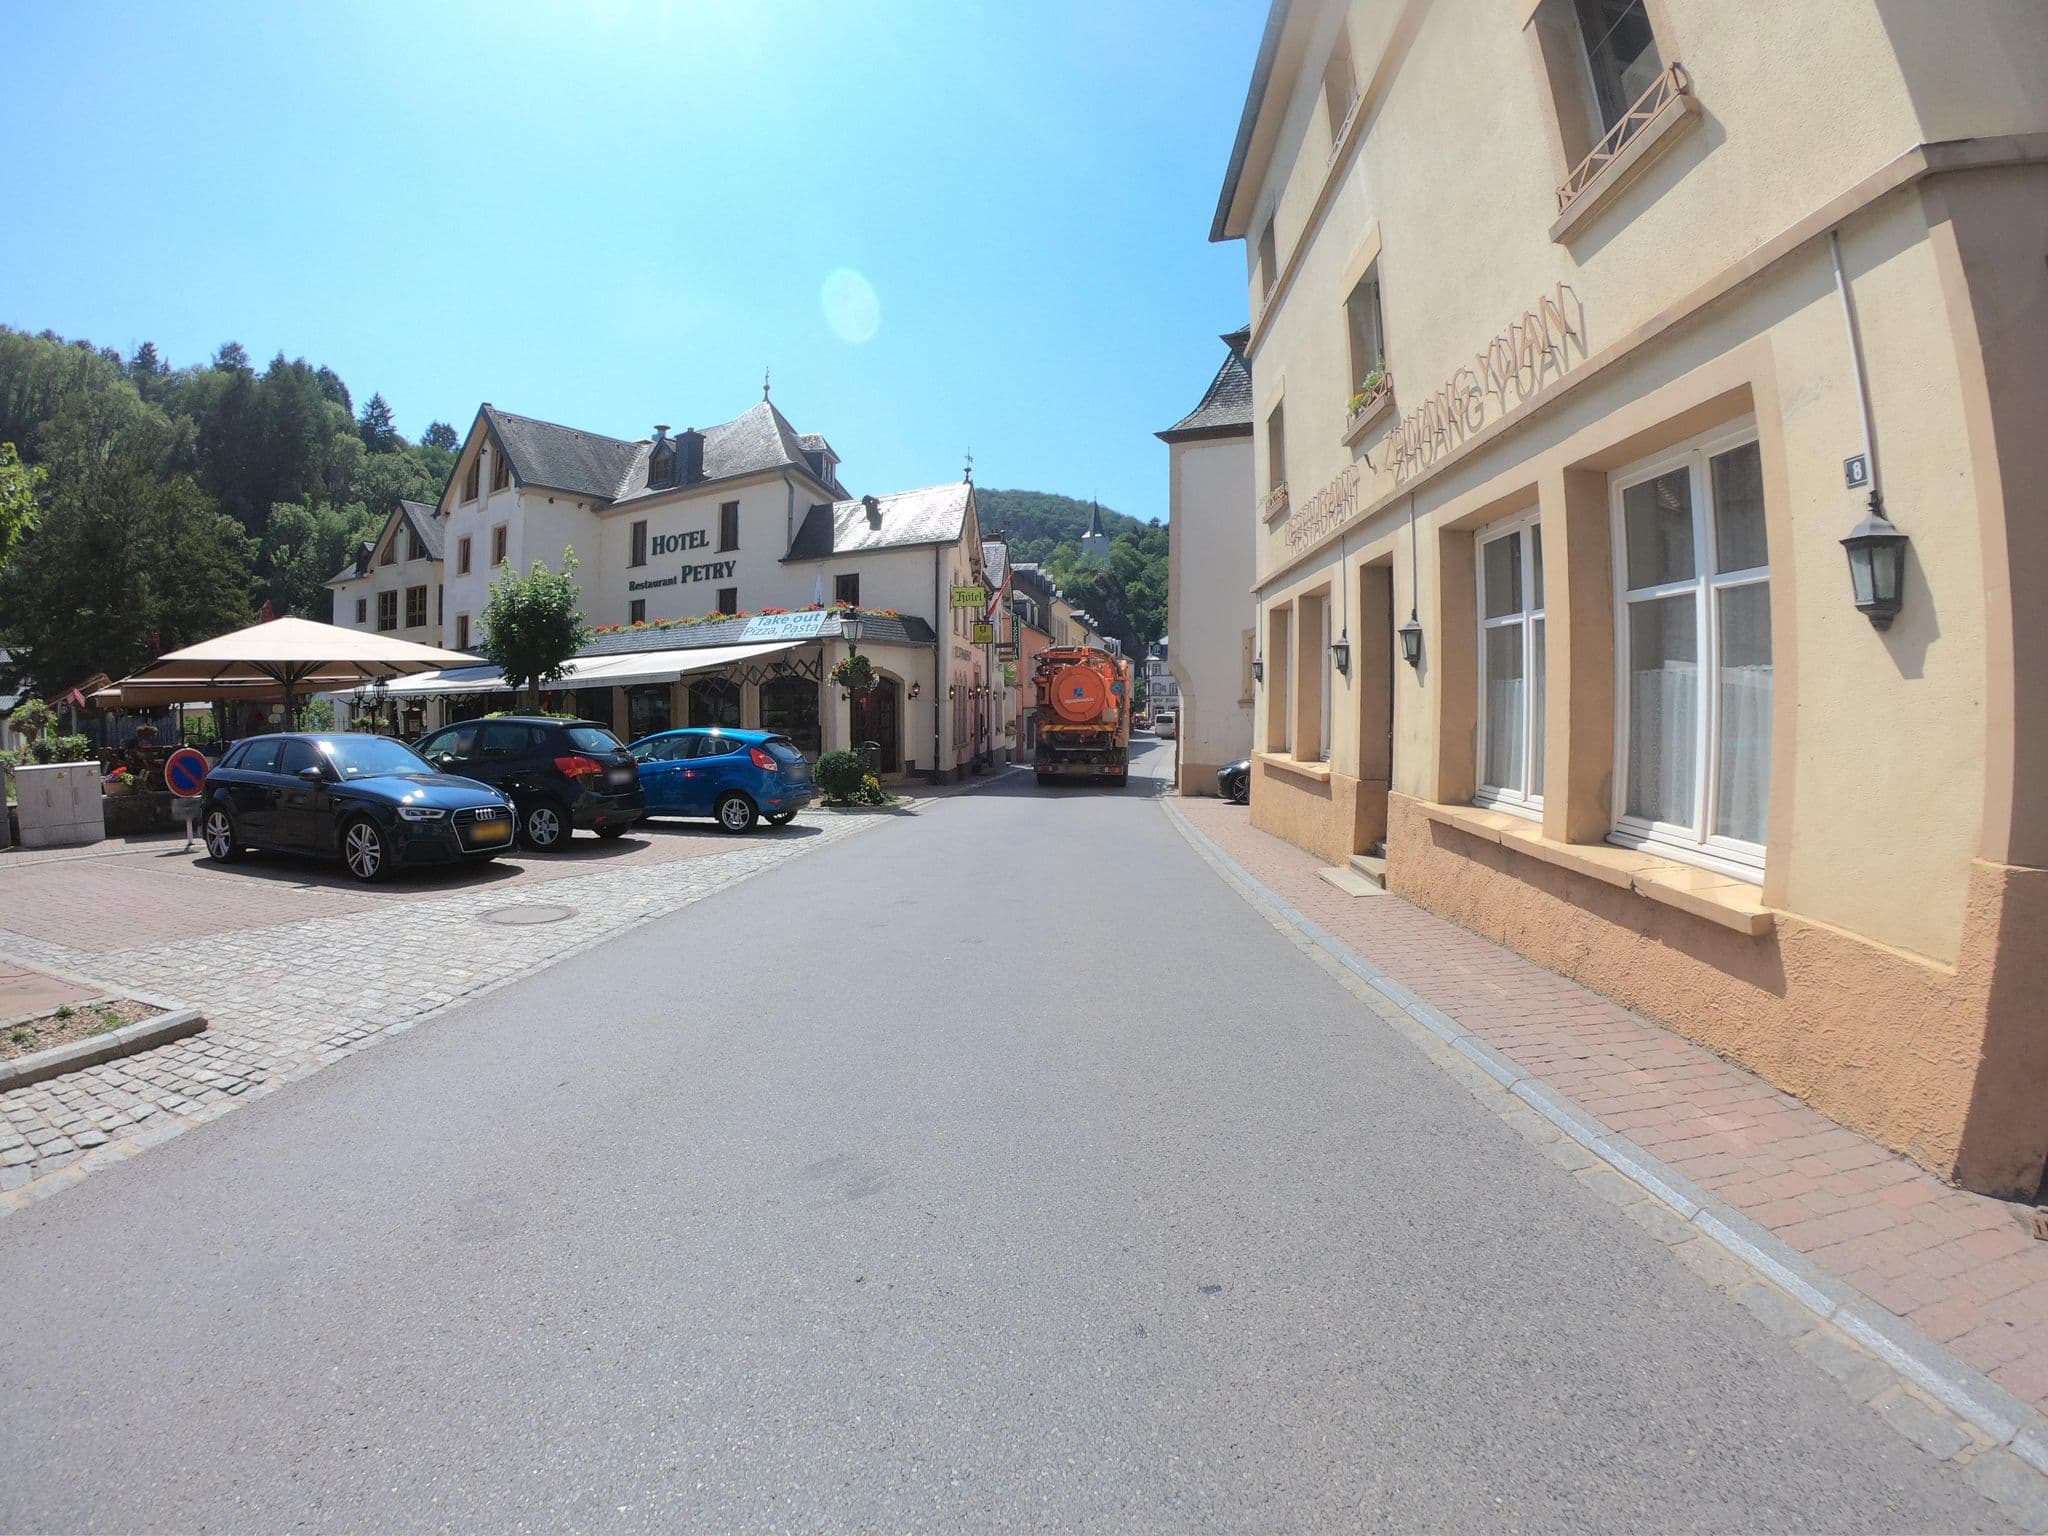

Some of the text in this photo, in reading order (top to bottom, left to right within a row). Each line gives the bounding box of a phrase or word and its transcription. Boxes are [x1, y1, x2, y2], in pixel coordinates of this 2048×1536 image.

[1475, 281, 1582, 402] YUAN
[1852, 461, 1862, 480] 8
[652, 529, 710, 556] HOTEL
[628, 560, 736, 591] Restaurant PETRY
[743, 626, 777, 636] Pizza,
[782, 623, 818, 633] Pasta
[757, 612, 820, 626] Take out
